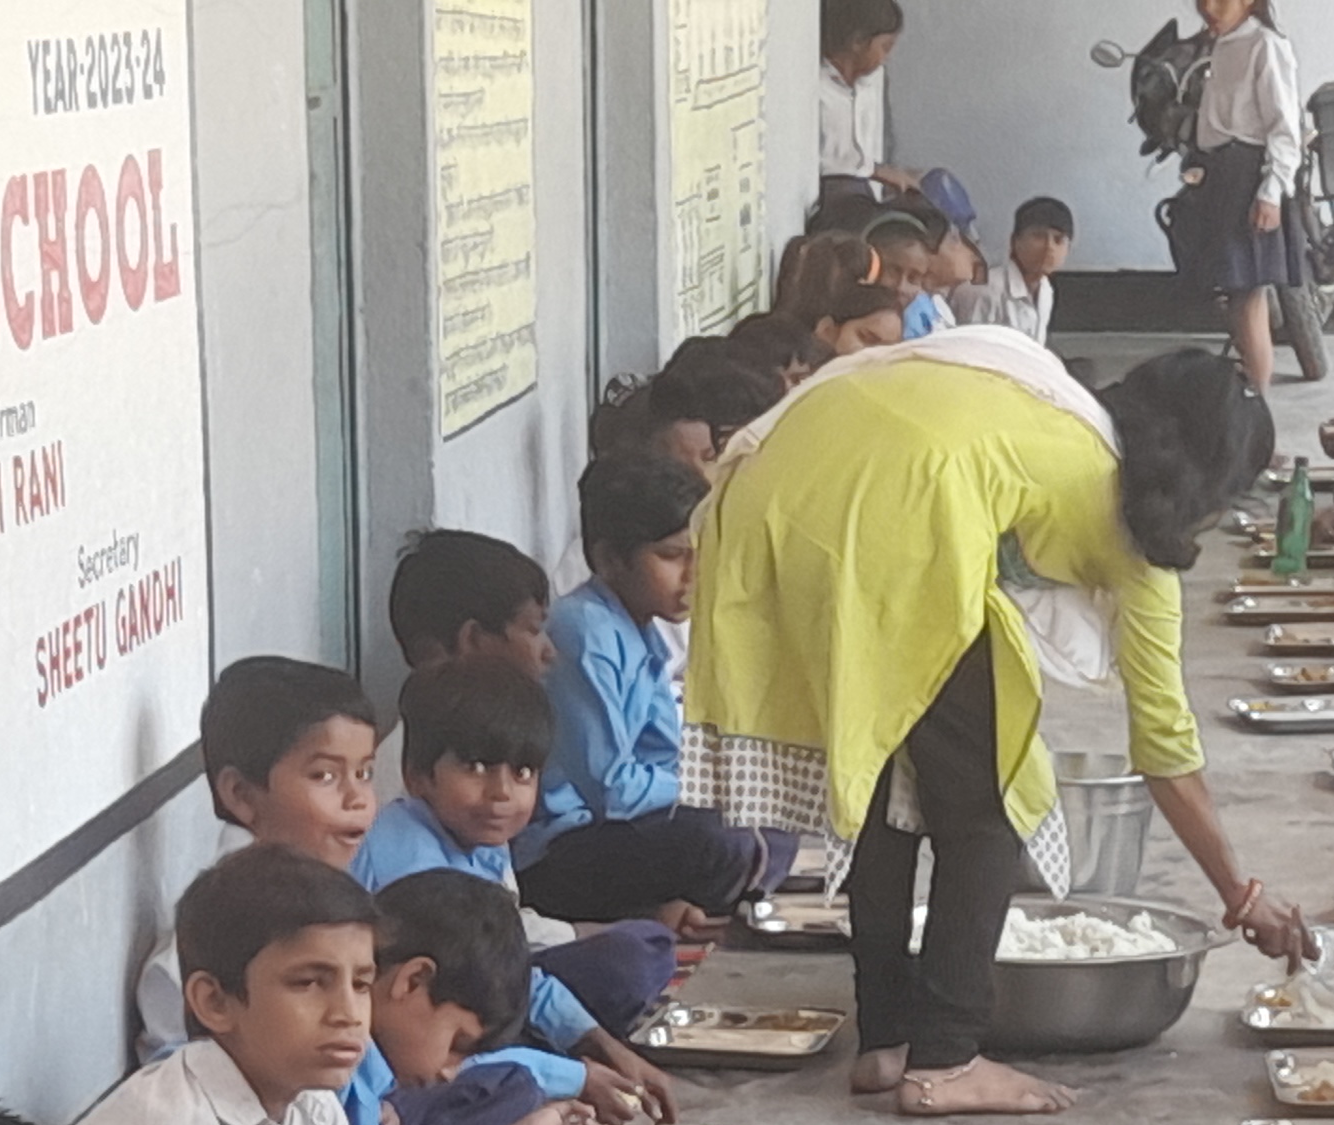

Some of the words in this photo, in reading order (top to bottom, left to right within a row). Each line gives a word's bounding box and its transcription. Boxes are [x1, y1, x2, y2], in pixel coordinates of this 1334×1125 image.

[13, 439, 66, 526] RANI
[78, 528, 139, 589] Secretary
[36, 600, 107, 708] SHEETU
[116, 555, 183, 656] GANDHI
